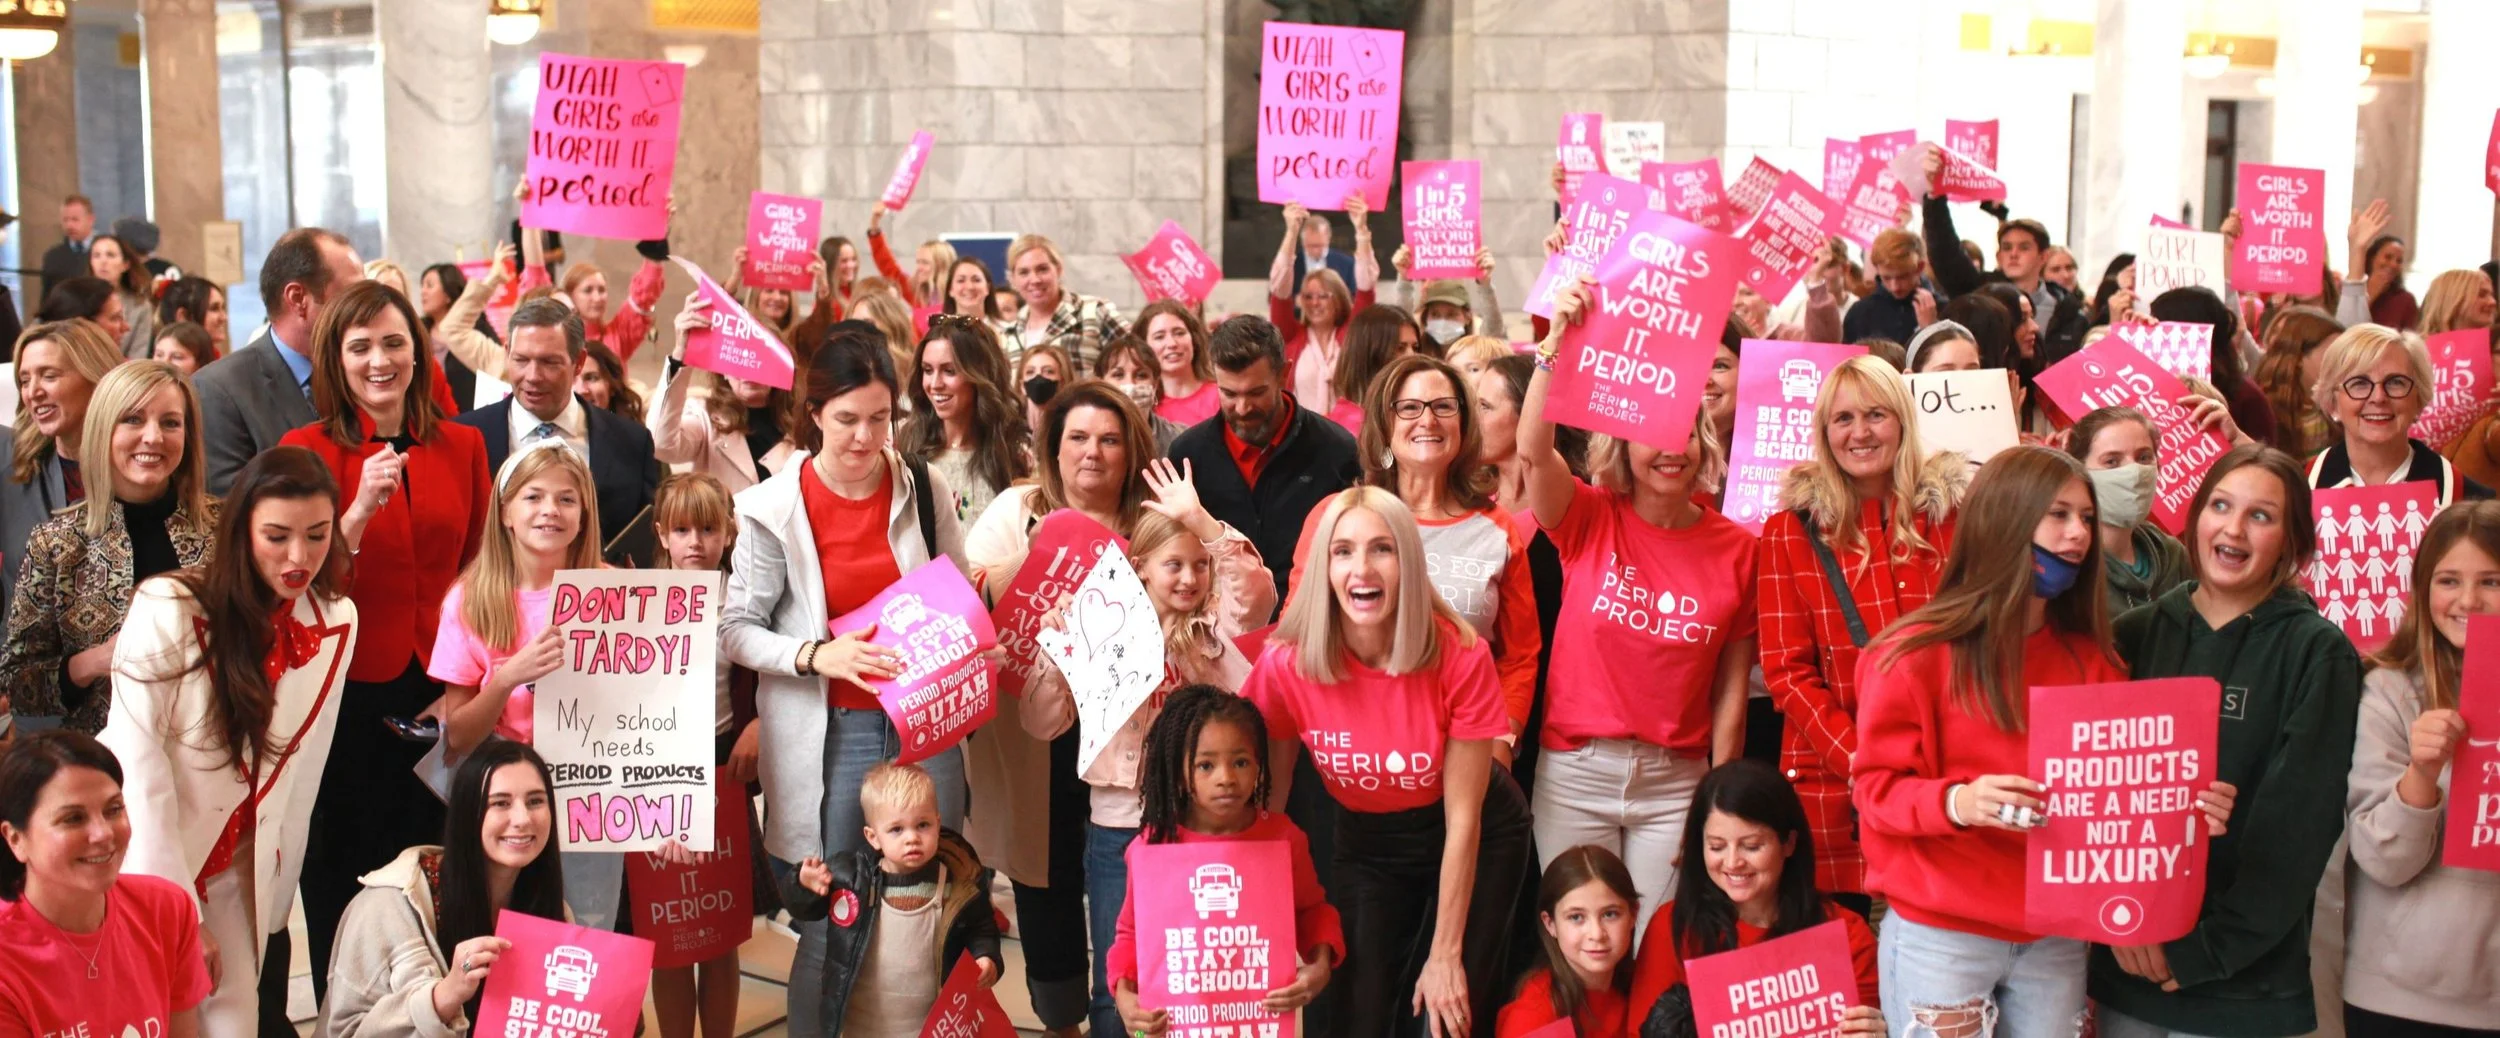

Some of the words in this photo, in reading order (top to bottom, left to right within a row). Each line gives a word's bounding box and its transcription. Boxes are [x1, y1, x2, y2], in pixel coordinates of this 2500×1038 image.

[1272, 36, 1333, 68] UTAH
[545, 63, 619, 97] UTAH
[1285, 70, 1350, 102] GIRLS
[553, 98, 622, 131] GIRLS
[1265, 106, 1346, 138] WORTH
[533, 130, 620, 168] WORTH
[1450, 183, 1467, 208] 5
[2256, 175, 2309, 195] GIRLS
[764, 202, 808, 224] GIRLS
[1787, 190, 1826, 227] PERIOD
[2266, 193, 2299, 211] ARE
[769, 221, 797, 236] ARE
[1588, 205, 1608, 232] in
[1609, 209, 1630, 239] 5
[2250, 209, 2313, 228] WORTH
[757, 231, 808, 252] WORTH
[1415, 241, 1476, 263] period
[1563, 228, 1616, 257] girl
[1628, 231, 1711, 278] GIRLS
[1748, 233, 1808, 281] UXURY!
[2148, 233, 2196, 264] GIRL
[1628, 268, 1689, 306] ARE
[712, 311, 764, 341] PERIO
[1601, 286, 1703, 340] WORTH
[1623, 327, 1651, 358] IT.
[720, 353, 763, 369] PROJECT
[1578, 345, 1677, 399] PERIOD.
[2452, 359, 2475, 389] 5
[1594, 382, 1613, 395] THE
[2094, 381, 2131, 409] in
[2116, 364, 2155, 396] 5
[1588, 402, 1645, 426] PROJECT
[1757, 405, 1781, 424] BE
[1787, 408, 1813, 427] CO
[2133, 391, 2170, 418] rls
[1755, 423, 1813, 444] STAY
[2155, 432, 2222, 498] period
[1738, 483, 1759, 498] FOR
[552, 583, 657, 626] DON'T
[664, 584, 708, 626] BE
[1440, 583, 1496, 616] RLS
[945, 615, 972, 642] IN
[1591, 594, 1717, 645] PROJECT
[569, 629, 692, 676] TARDY!
[895, 634, 978, 687] SCHOOL!
[897, 682, 941, 713] PERIOD
[941, 656, 987, 694] PRODUCTS
[907, 709, 937, 730] FOR
[929, 669, 989, 725] UTAH
[557, 697, 594, 748] My
[616, 702, 677, 732] school
[932, 691, 989, 741] STUDENTS!
[1308, 730, 1352, 748] THE
[2072, 714, 2175, 753] PERIOD
[592, 736, 655, 766] needs
[546, 764, 613, 782] PERIOD
[622, 765, 706, 782] PRODUCTS
[2045, 748, 2200, 788] PRODUCTS
[2046, 791, 2096, 817] ARE
[2103, 791, 2122, 816] A
[2129, 785, 2195, 816] NEED,
[566, 792, 693, 844] NOW!
[2085, 820, 2132, 845] NOT
[2140, 818, 2157, 844] A
[681, 870, 704, 895] IT.
[651, 890, 736, 925] PERIOD.
[673, 934, 722, 953] PROJECT
[1164, 927, 1198, 950] BE
[1203, 925, 1271, 948] COOL,
[1166, 947, 1238, 973] STAY
[1243, 947, 1269, 968] IN
[1166, 968, 1269, 995] SCHOOL!
[1728, 962, 1821, 1015] PERIOD
[508, 996, 542, 1021] BE
[545, 1003, 609, 1037] COOL,
[1165, 1004, 1209, 1025] ERIOD
